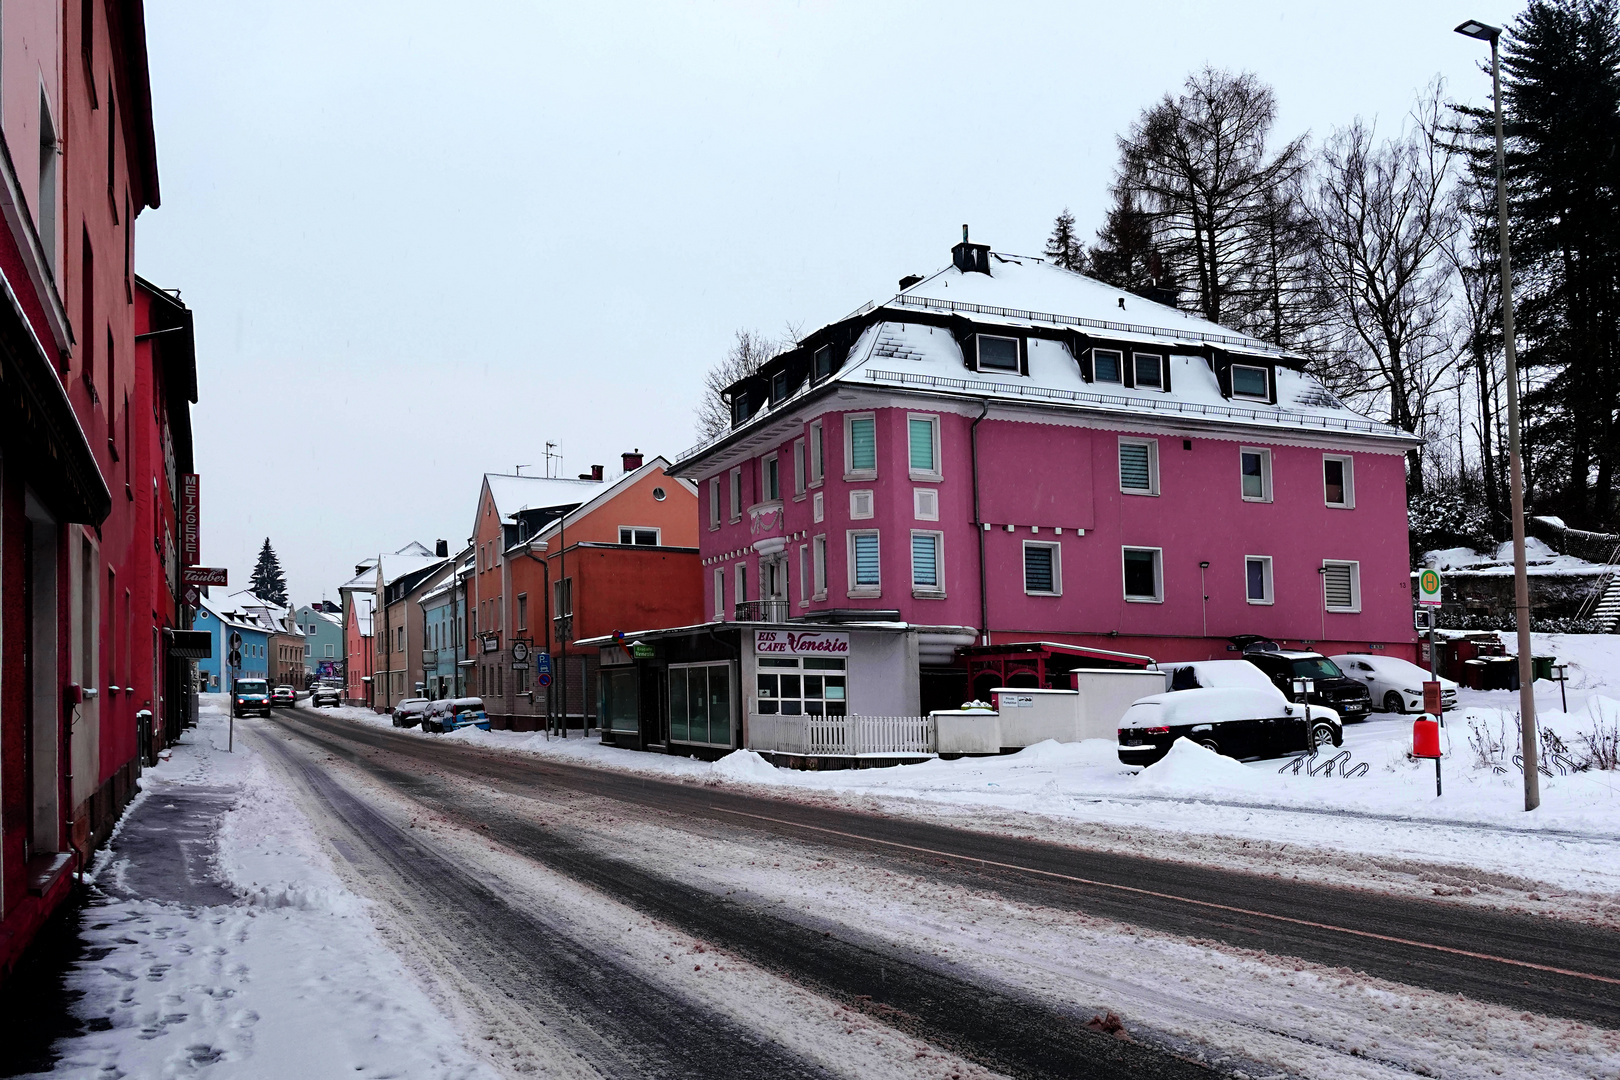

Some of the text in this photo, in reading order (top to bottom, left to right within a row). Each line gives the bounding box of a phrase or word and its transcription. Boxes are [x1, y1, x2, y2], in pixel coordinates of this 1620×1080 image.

[185, 475, 197, 562] METZGEREI
[184, 570, 227, 583] Täuber
[1426, 575, 1434, 589] H
[757, 632, 777, 642] EIS
[787, 632, 849, 653] Venezia
[757, 642, 787, 652] CAFE
